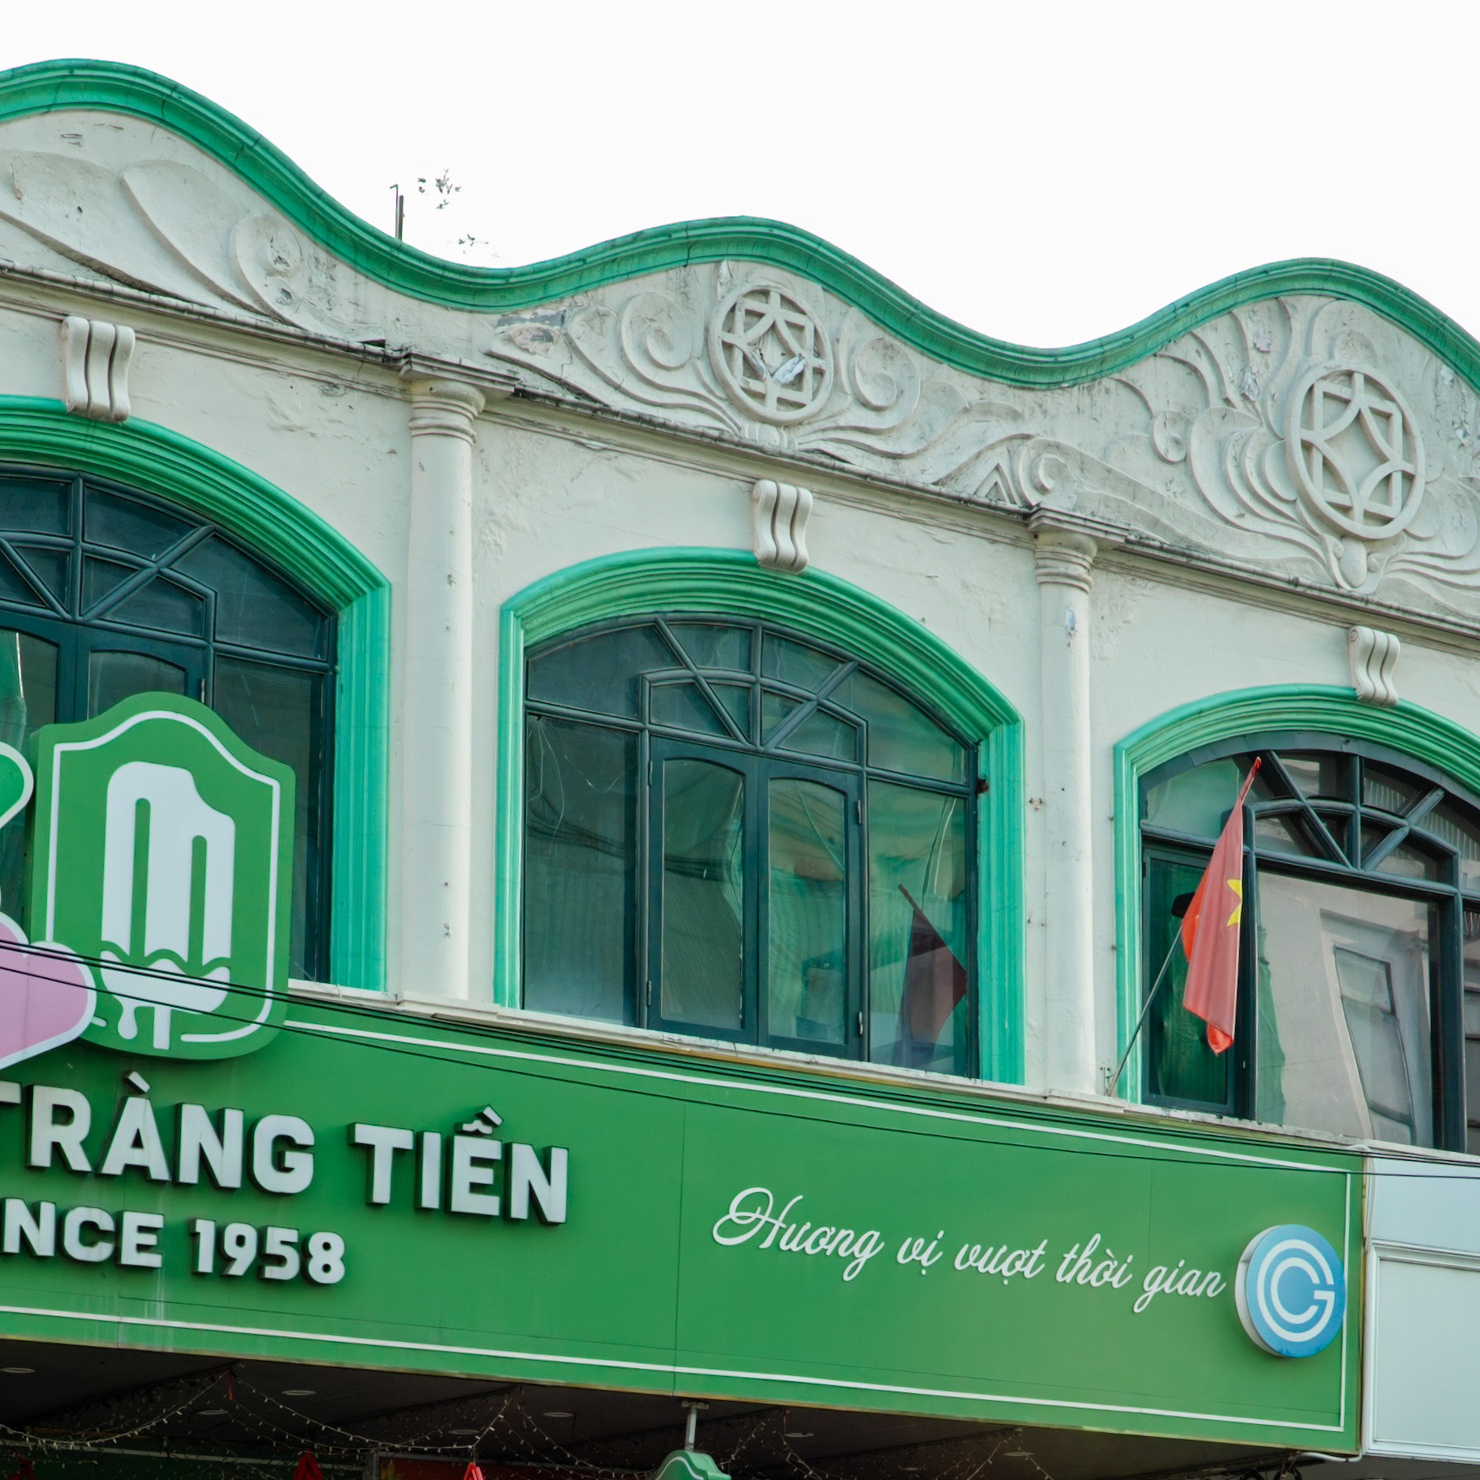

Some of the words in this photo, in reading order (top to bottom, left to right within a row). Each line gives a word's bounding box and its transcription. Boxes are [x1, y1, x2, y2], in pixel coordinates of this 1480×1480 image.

[350, 1105, 568, 1225] TIỀN
[190, 1217, 346, 1285] 1958
[713, 1187, 884, 1282] Hương
[898, 1231, 945, 1276] vị
[954, 1239, 1048, 1285] vượt
[1055, 1233, 1134, 1290] thời
[1133, 1260, 1227, 1313] gian
